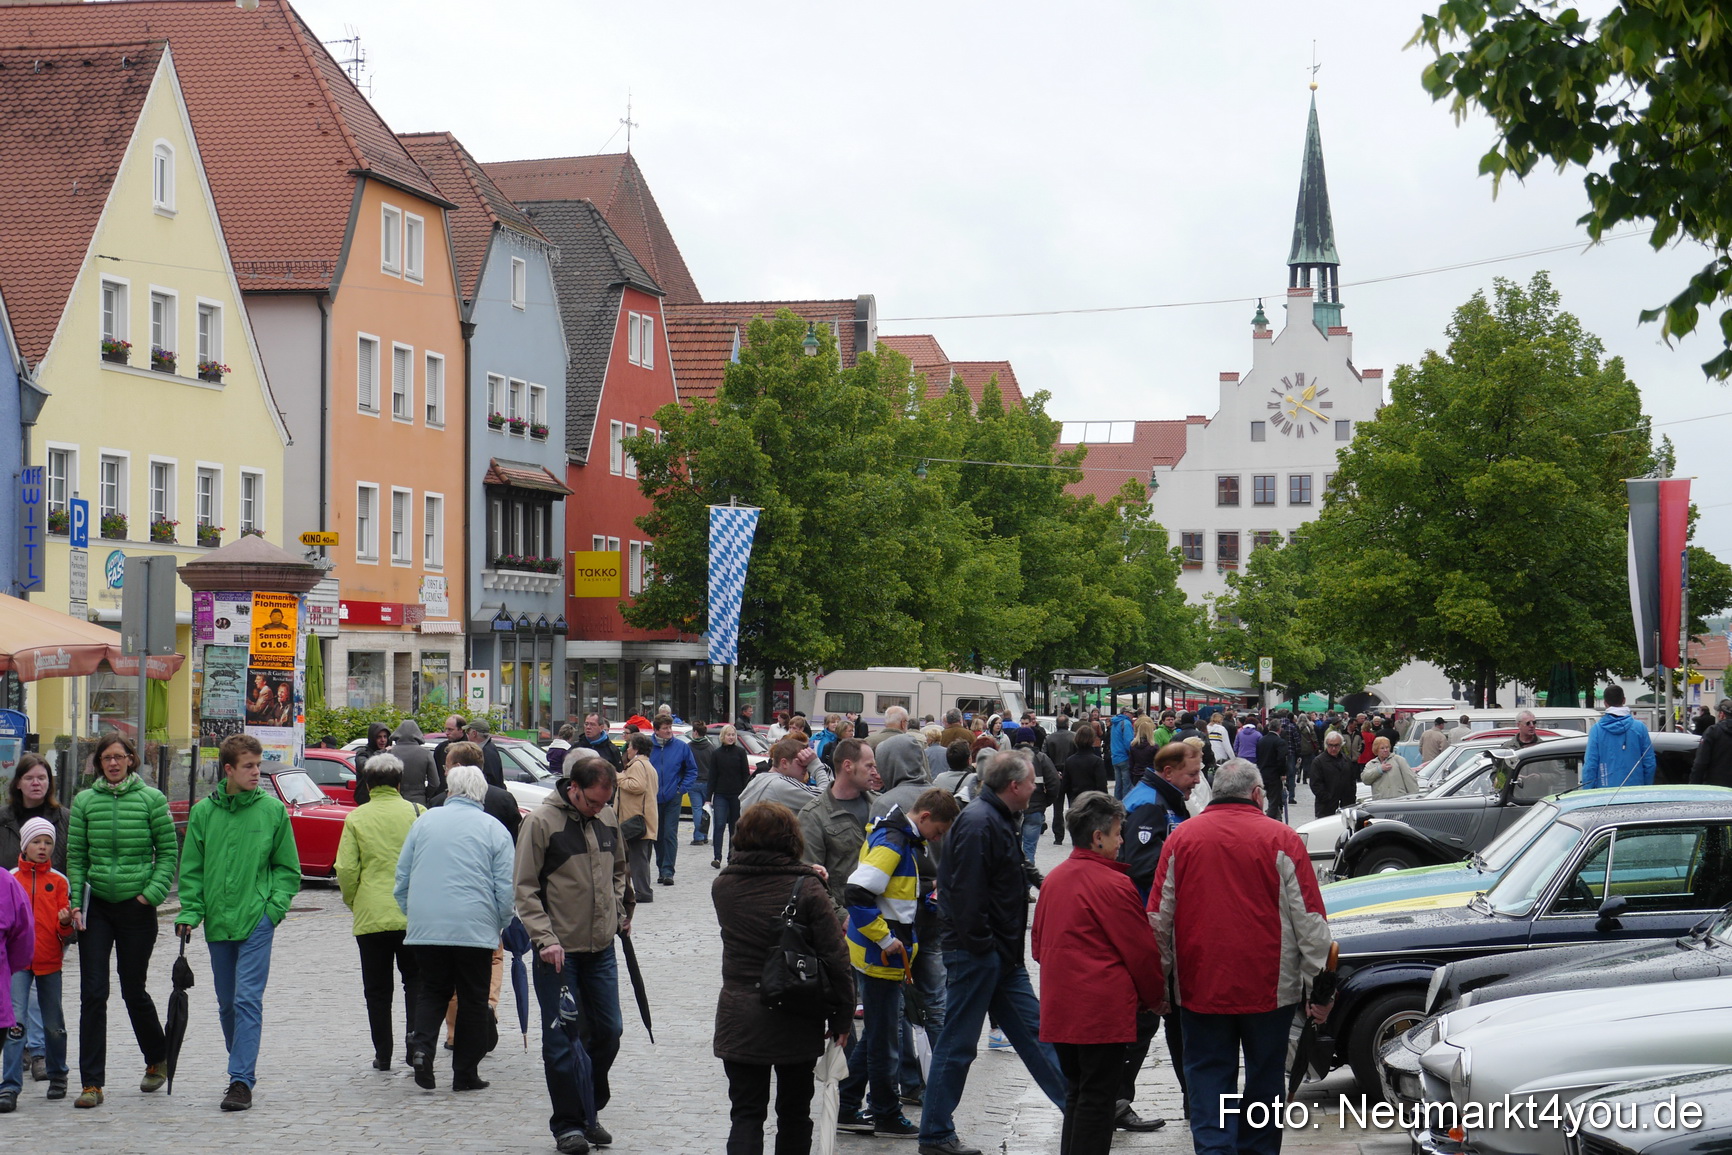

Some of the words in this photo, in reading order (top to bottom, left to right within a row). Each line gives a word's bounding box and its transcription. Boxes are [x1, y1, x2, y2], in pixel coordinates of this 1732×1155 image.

[22, 467, 42, 485] CAFÉ
[74, 504, 85, 541] P
[22, 488, 41, 579] WITTL
[303, 534, 321, 543] KINO
[427, 579, 438, 590] OBST
[425, 590, 443, 602] GEMÜSE
[255, 600, 296, 609] Flohmarkt
